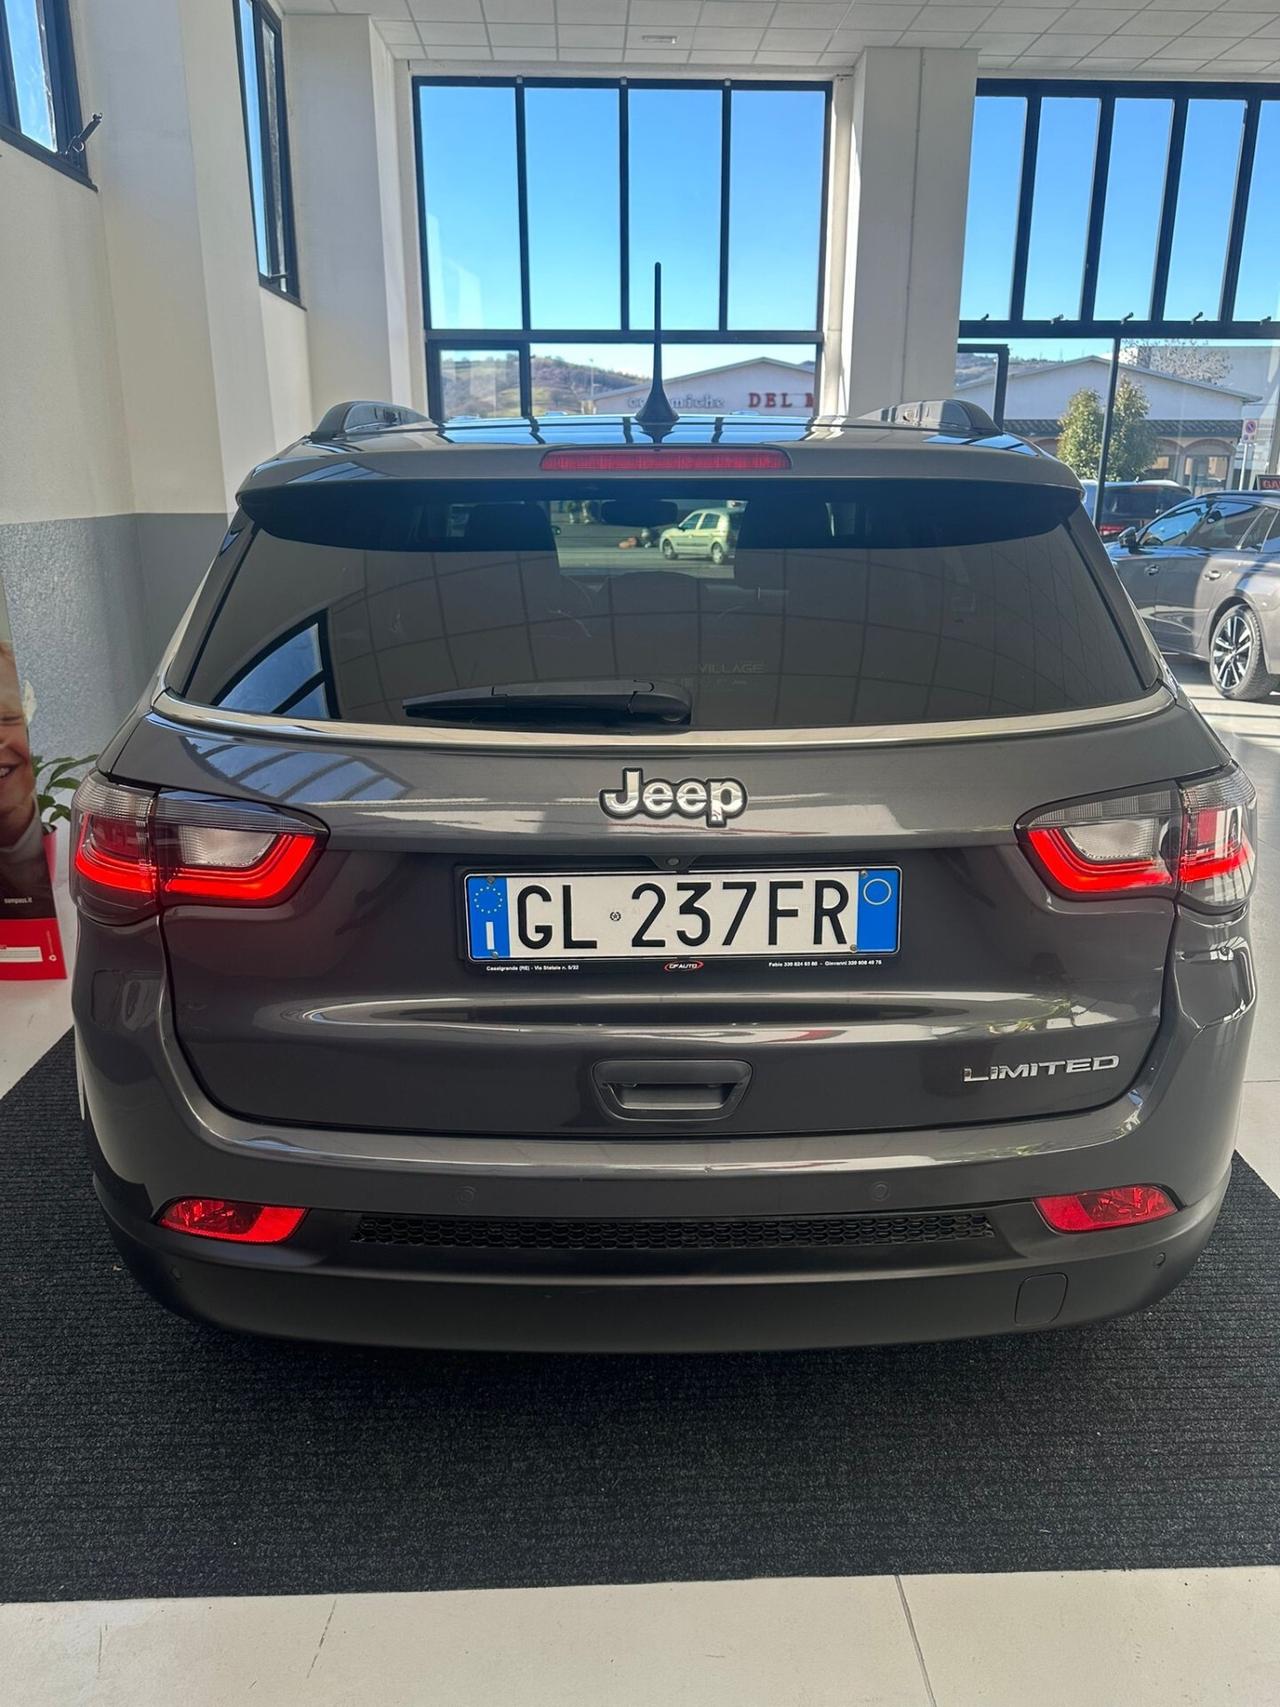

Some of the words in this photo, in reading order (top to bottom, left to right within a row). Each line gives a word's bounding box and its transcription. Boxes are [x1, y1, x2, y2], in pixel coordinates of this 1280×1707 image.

[748, 392, 793, 408] DEL
[601, 769, 746, 827] Jeep
[516, 884, 598, 950] GL
[631, 879, 850, 948] 237FR
[963, 1055, 1120, 1082] LIMITED
